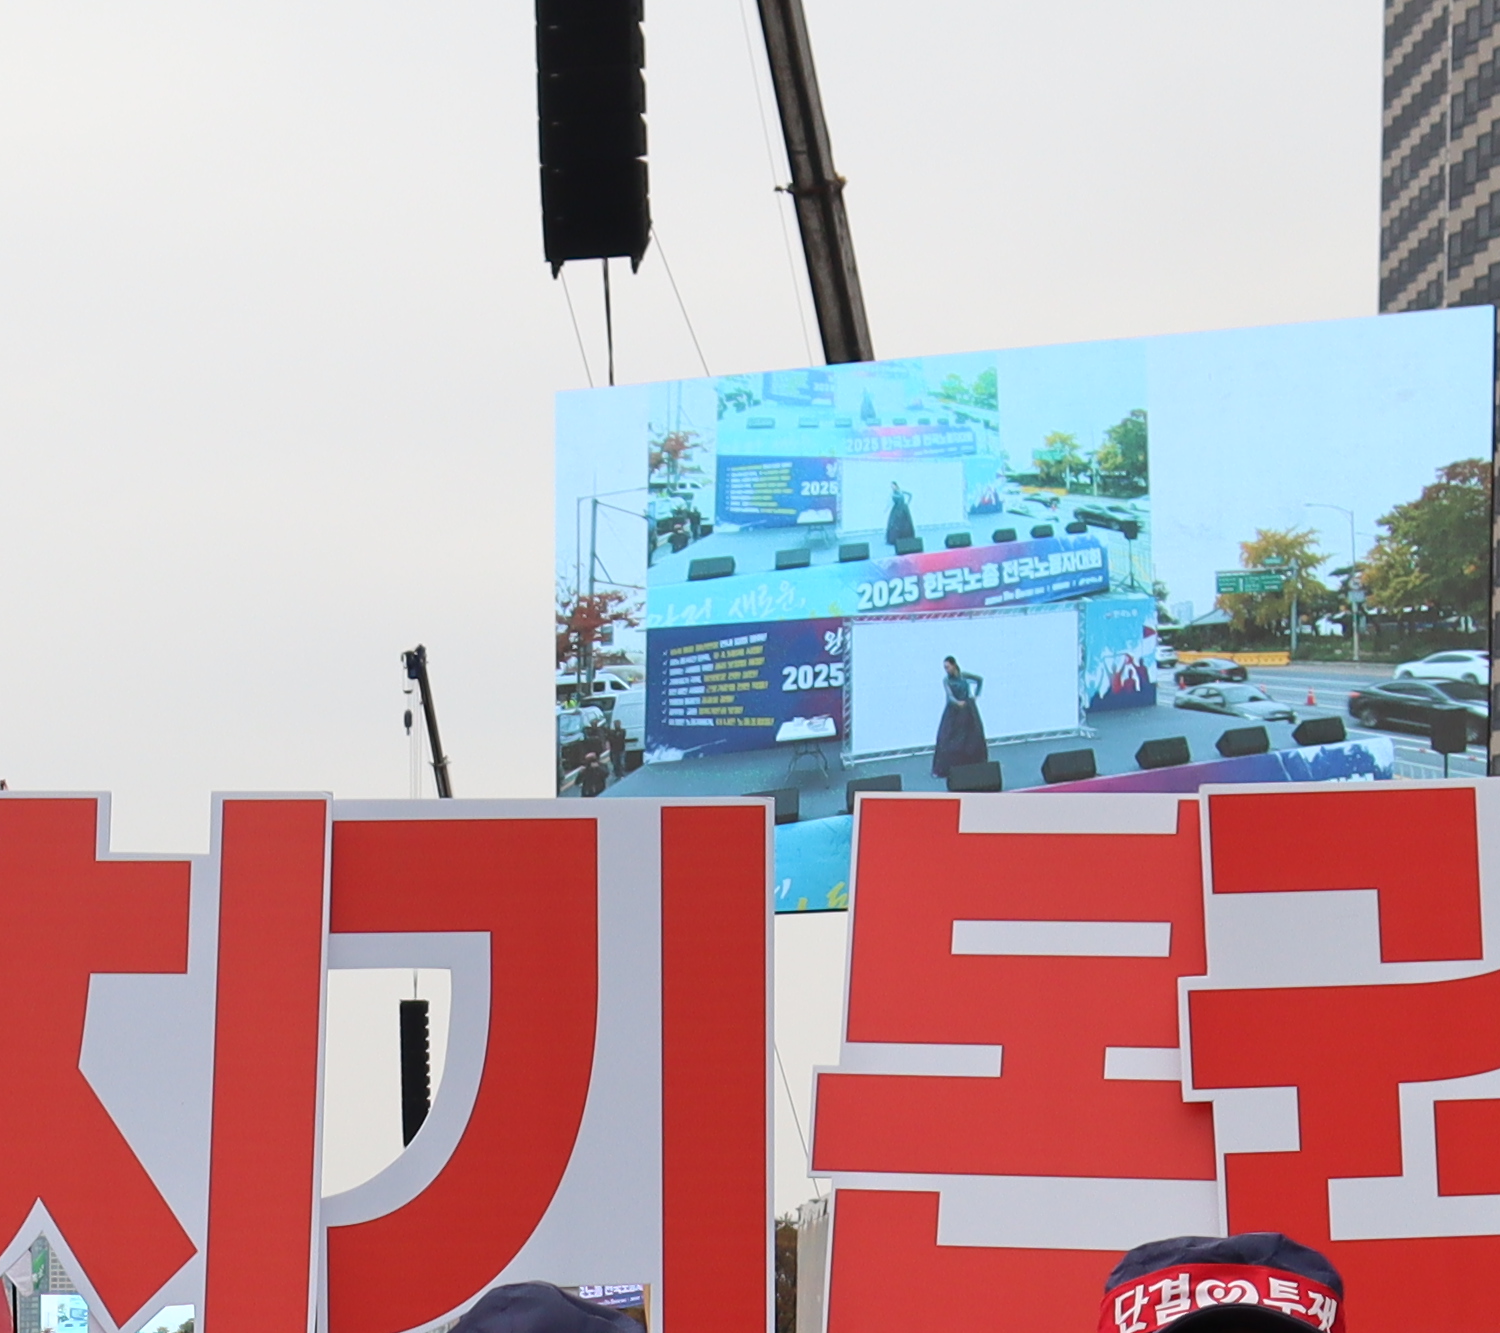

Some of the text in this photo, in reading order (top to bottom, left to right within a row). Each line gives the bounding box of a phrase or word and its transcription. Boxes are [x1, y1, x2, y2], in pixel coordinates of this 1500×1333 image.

[800, 480, 839, 497] 2025
[857, 575, 920, 612] 2025
[923, 564, 1000, 600] 한국노총
[782, 662, 846, 692] 2025
